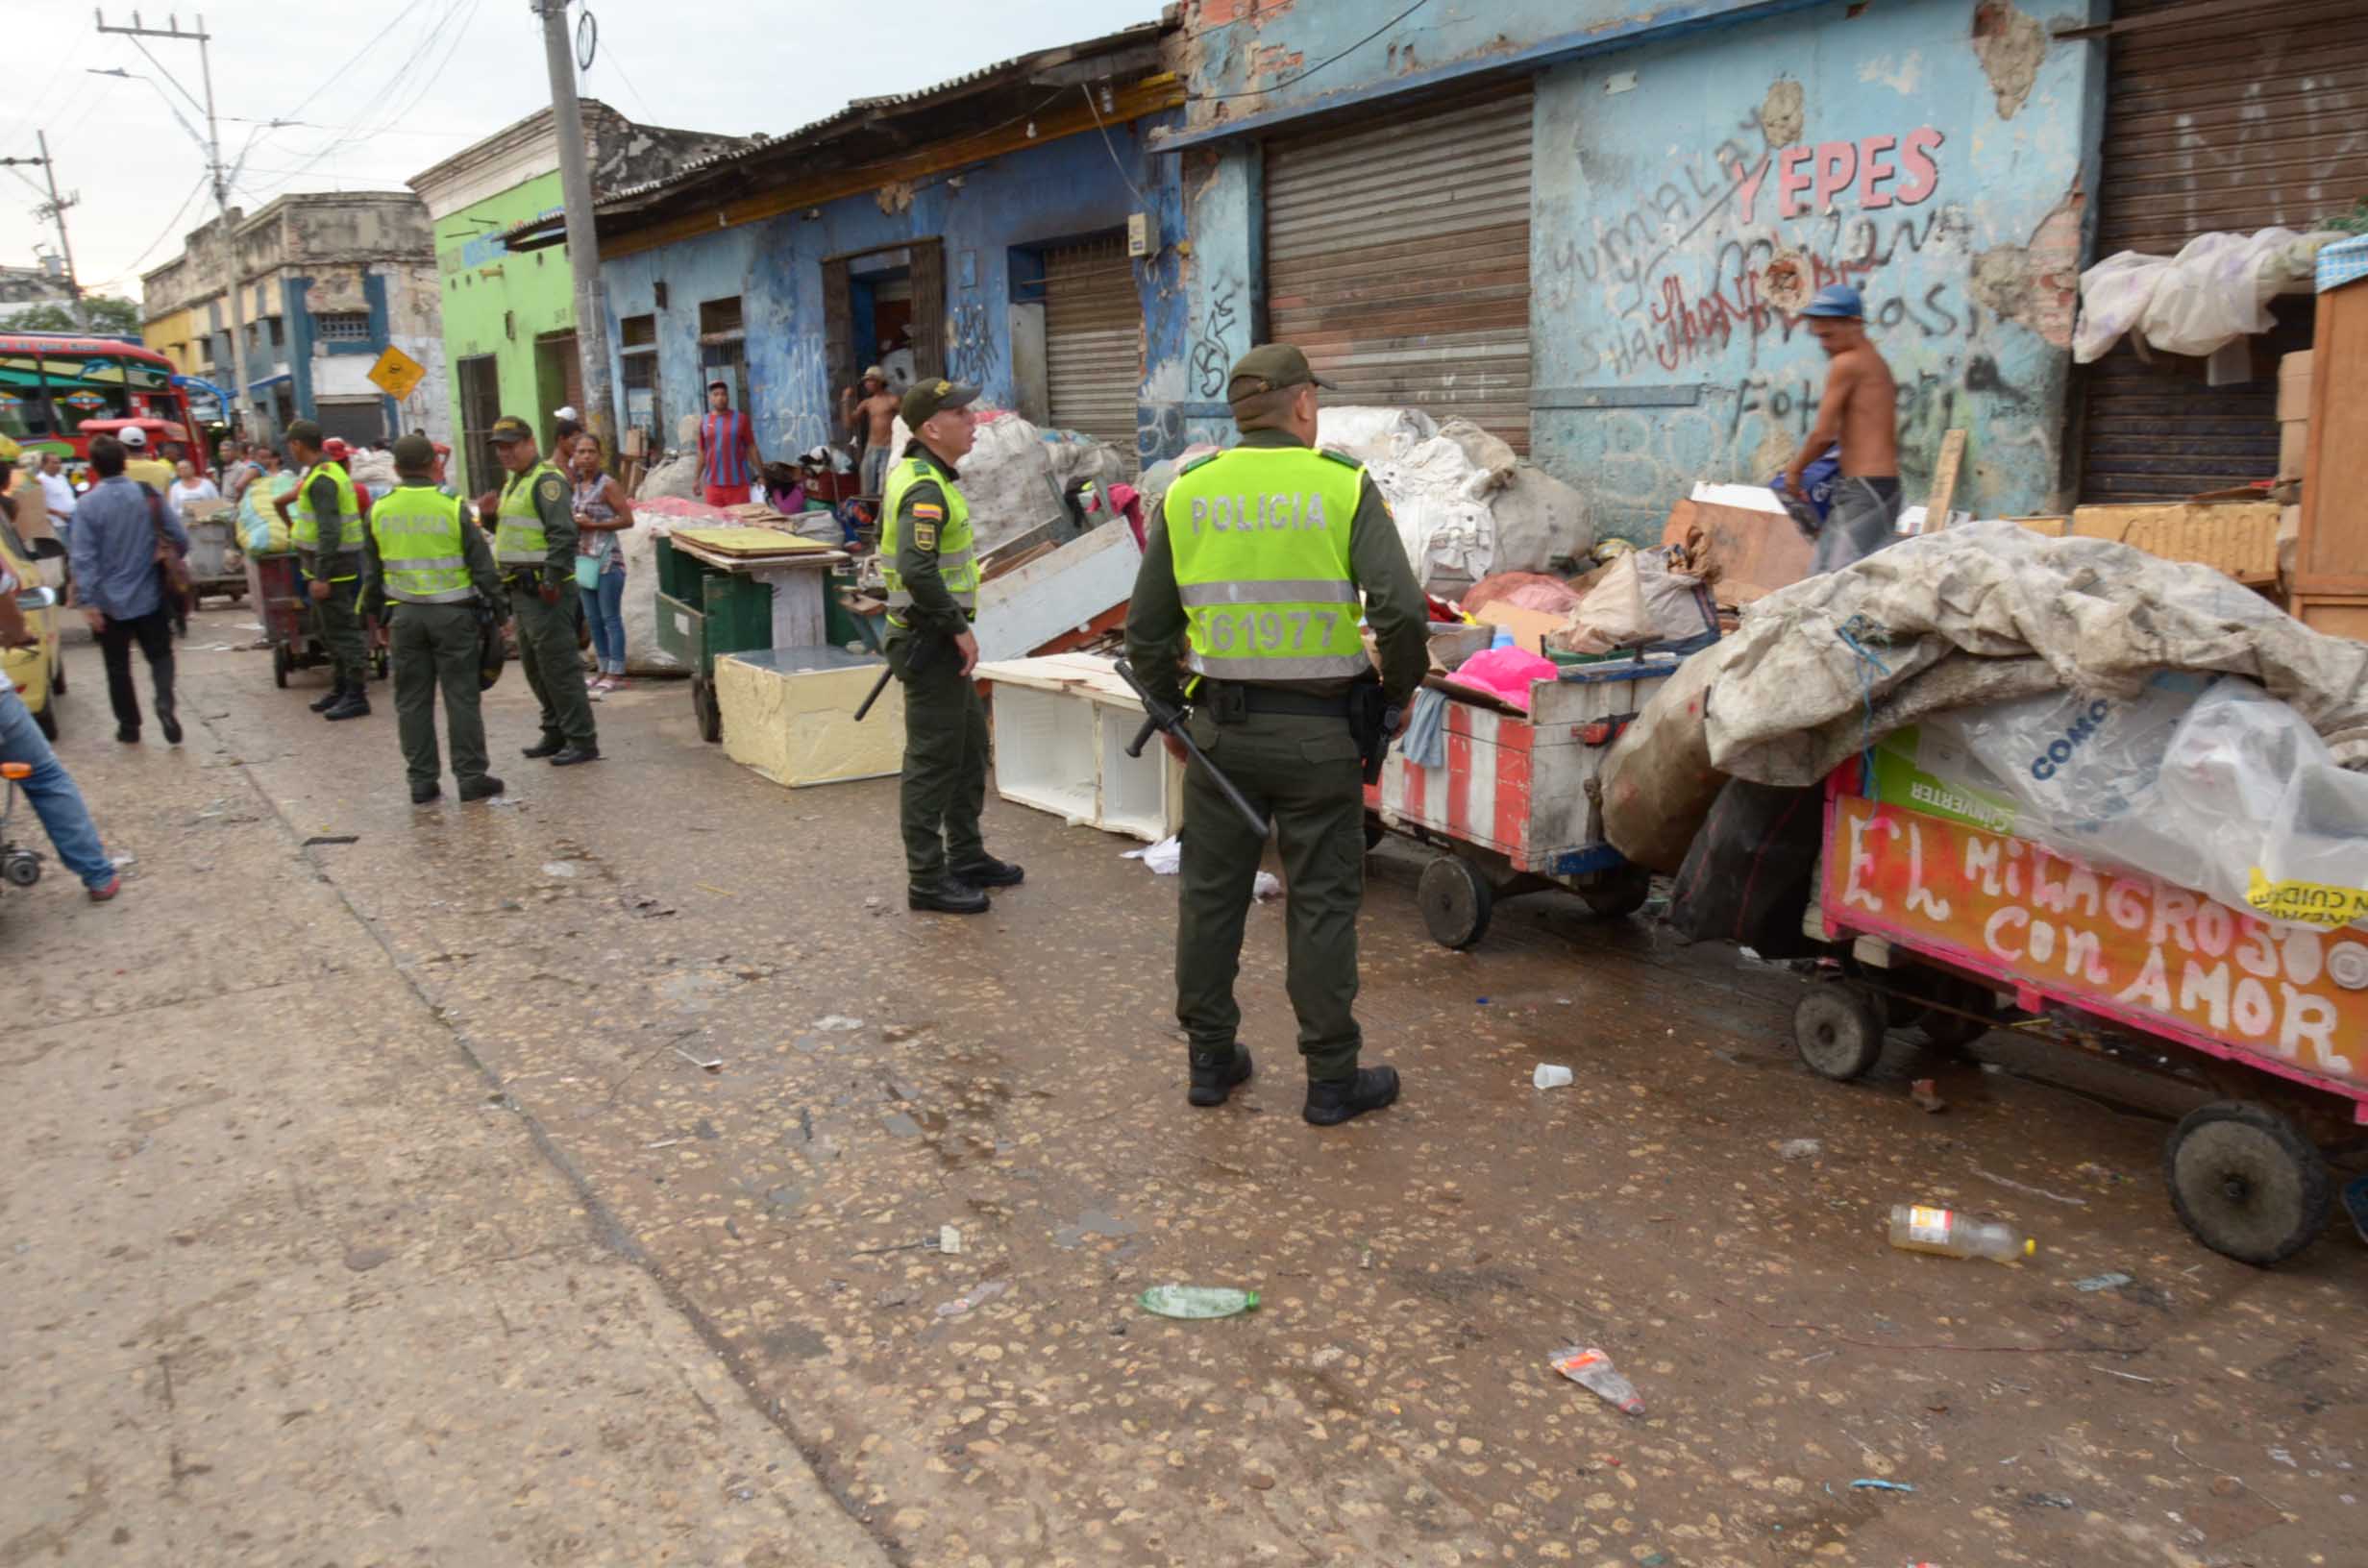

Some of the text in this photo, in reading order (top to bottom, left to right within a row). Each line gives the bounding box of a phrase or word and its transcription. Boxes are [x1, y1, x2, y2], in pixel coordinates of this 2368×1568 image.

[1733, 126, 1944, 224] YEPES
[1191, 492, 1327, 534] POLICIA
[2114, 944, 2354, 1074] AMOR
